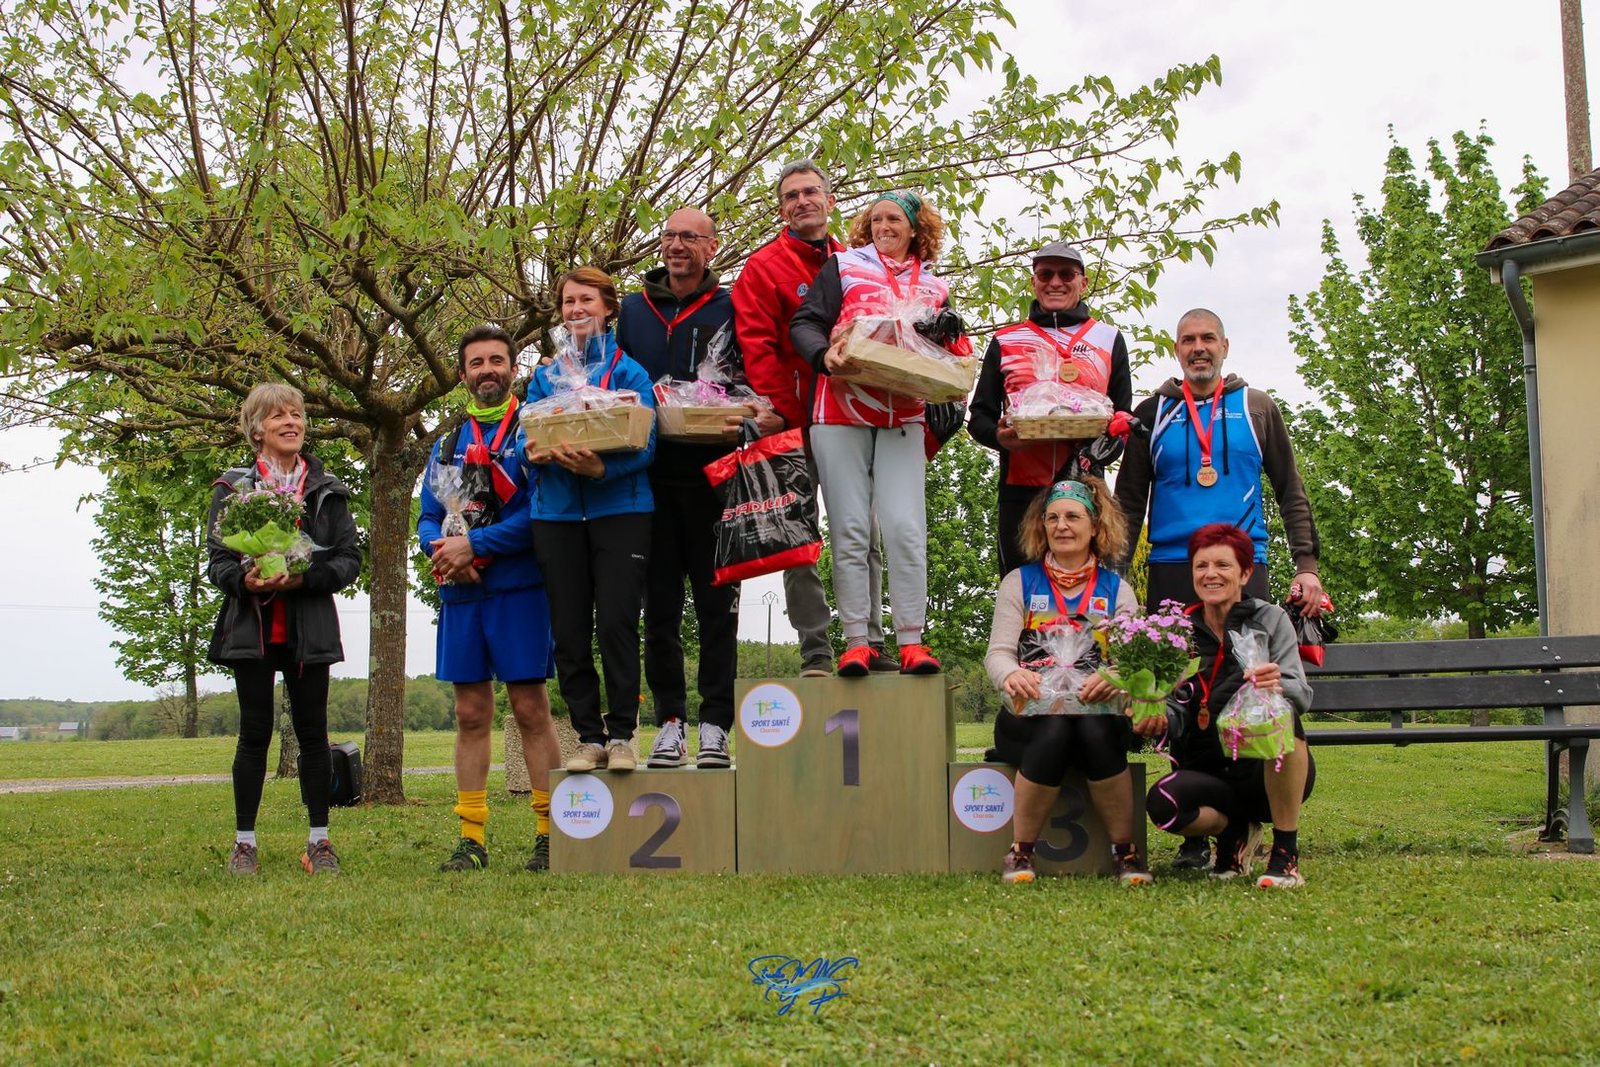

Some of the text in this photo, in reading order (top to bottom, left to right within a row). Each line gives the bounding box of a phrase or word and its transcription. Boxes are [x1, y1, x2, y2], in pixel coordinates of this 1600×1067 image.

[721, 491, 797, 522] SADIUM
[751, 719, 771, 728] SPORT
[825, 709, 860, 786] 1
[563, 810, 581, 818] SPORT
[964, 804, 984, 812] SPORT
[1035, 785, 1089, 862] 3
[628, 791, 682, 868] 2
